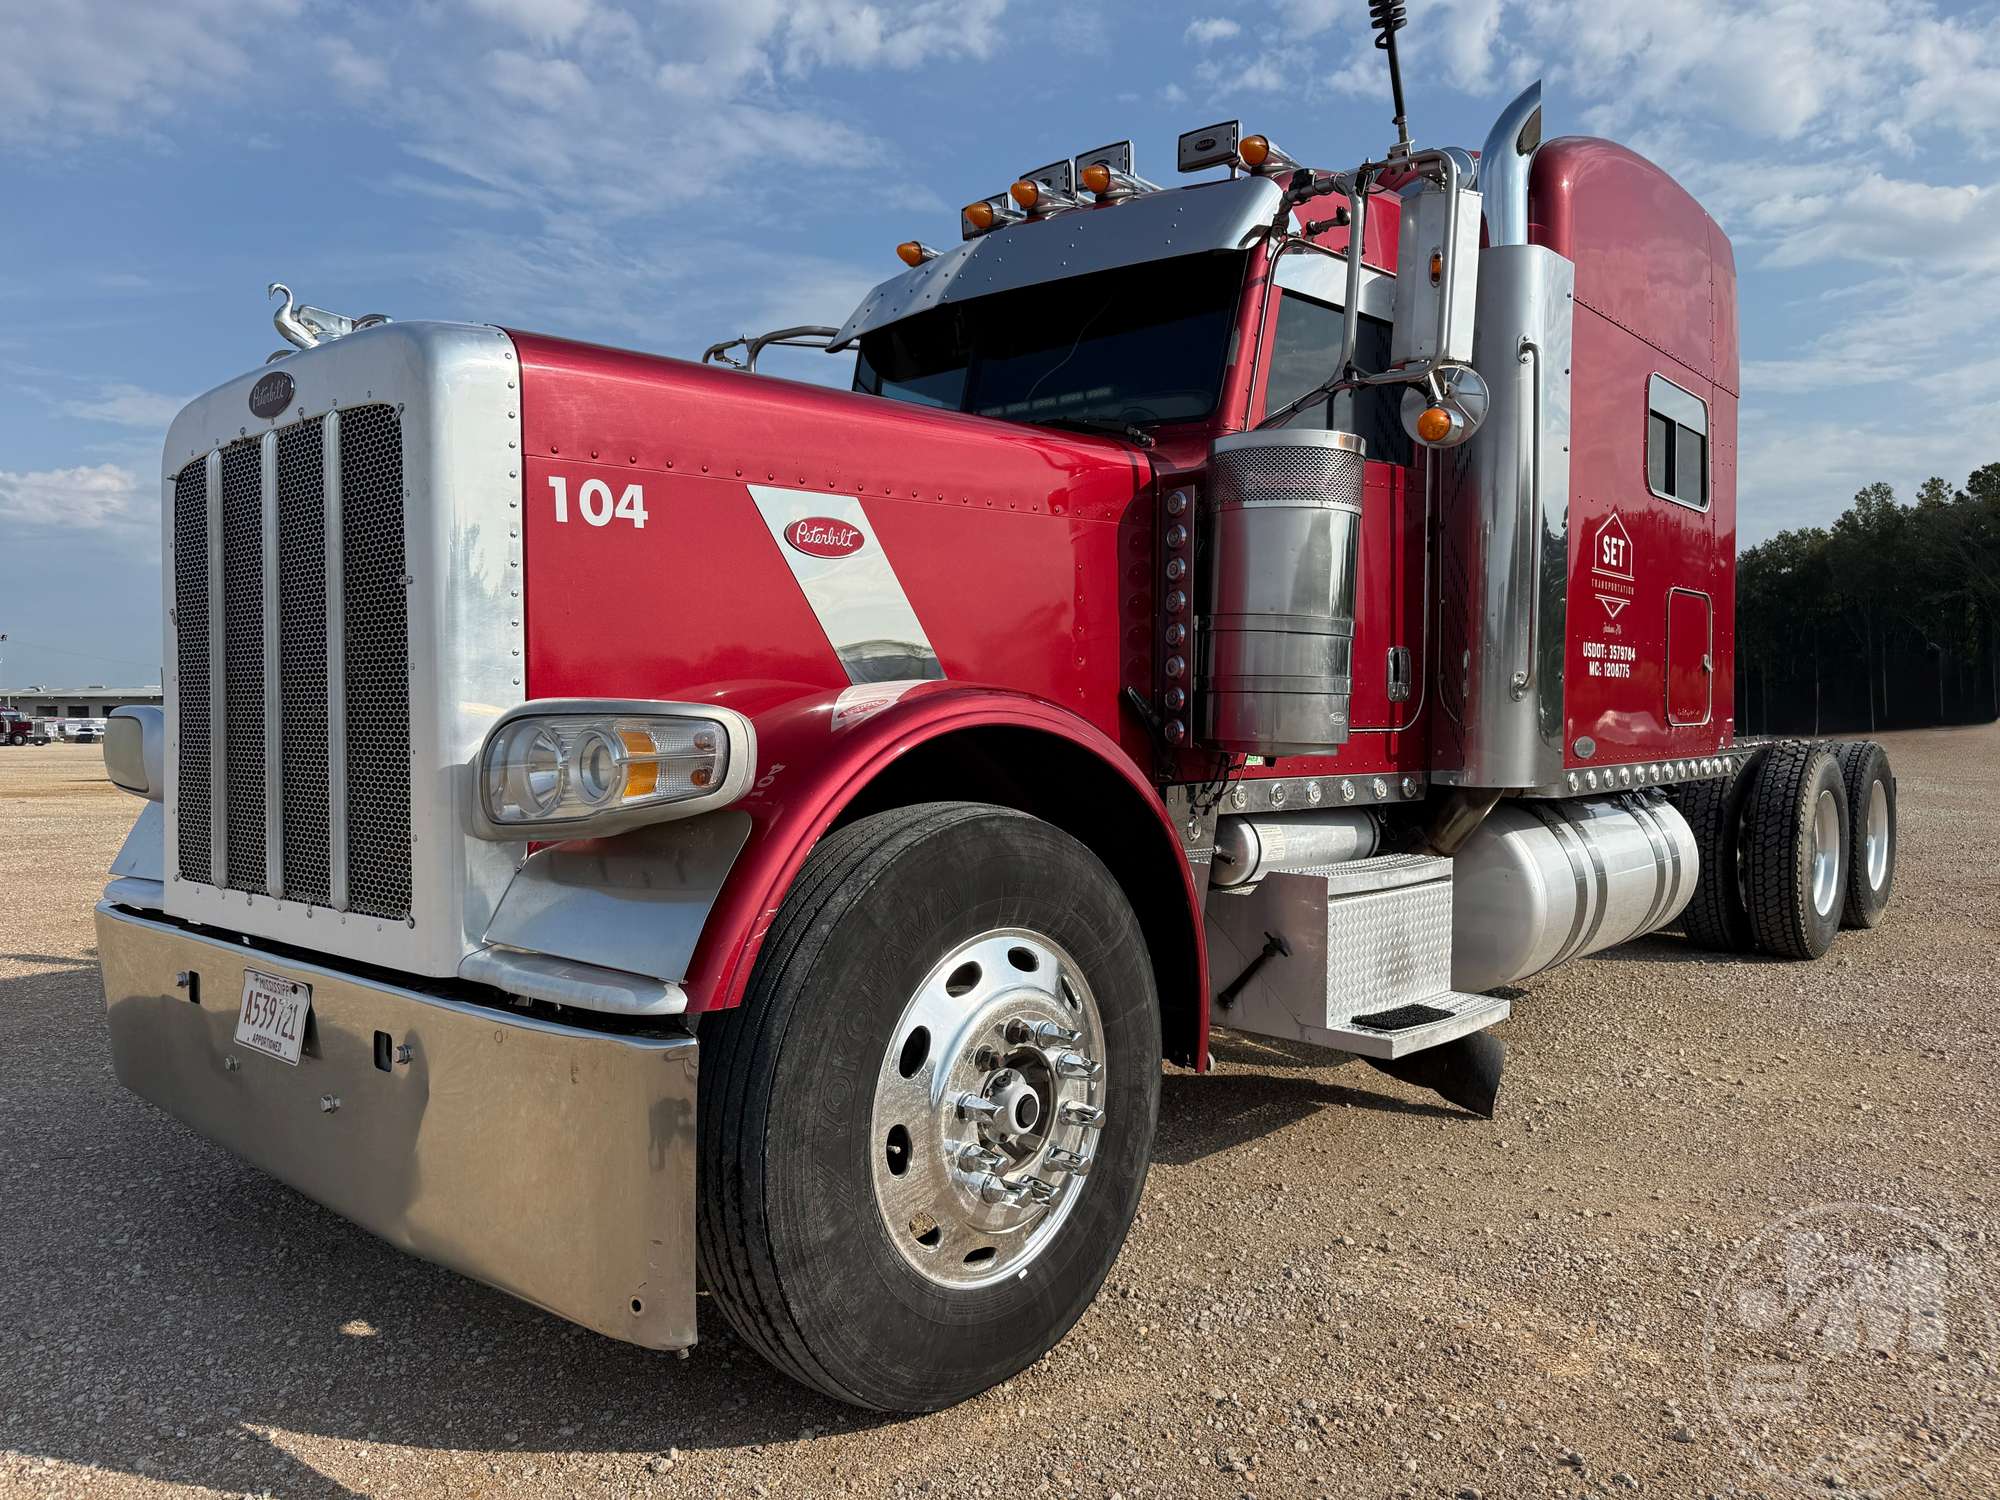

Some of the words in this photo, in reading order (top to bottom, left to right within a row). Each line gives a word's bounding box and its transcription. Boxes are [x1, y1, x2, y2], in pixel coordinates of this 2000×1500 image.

[253, 380, 287, 410] Peterbilt
[547, 475, 649, 529] 104
[796, 521, 859, 547] Peterbilt
[1603, 535, 1625, 567] SET
[1591, 578, 1634, 596] TRANSPORTATION
[1583, 641, 1607, 659] USDOT:
[1609, 644, 1636, 661] 3579784
[1589, 661, 1602, 676] MC:
[817, 887, 961, 1138] YOKOHAMA
